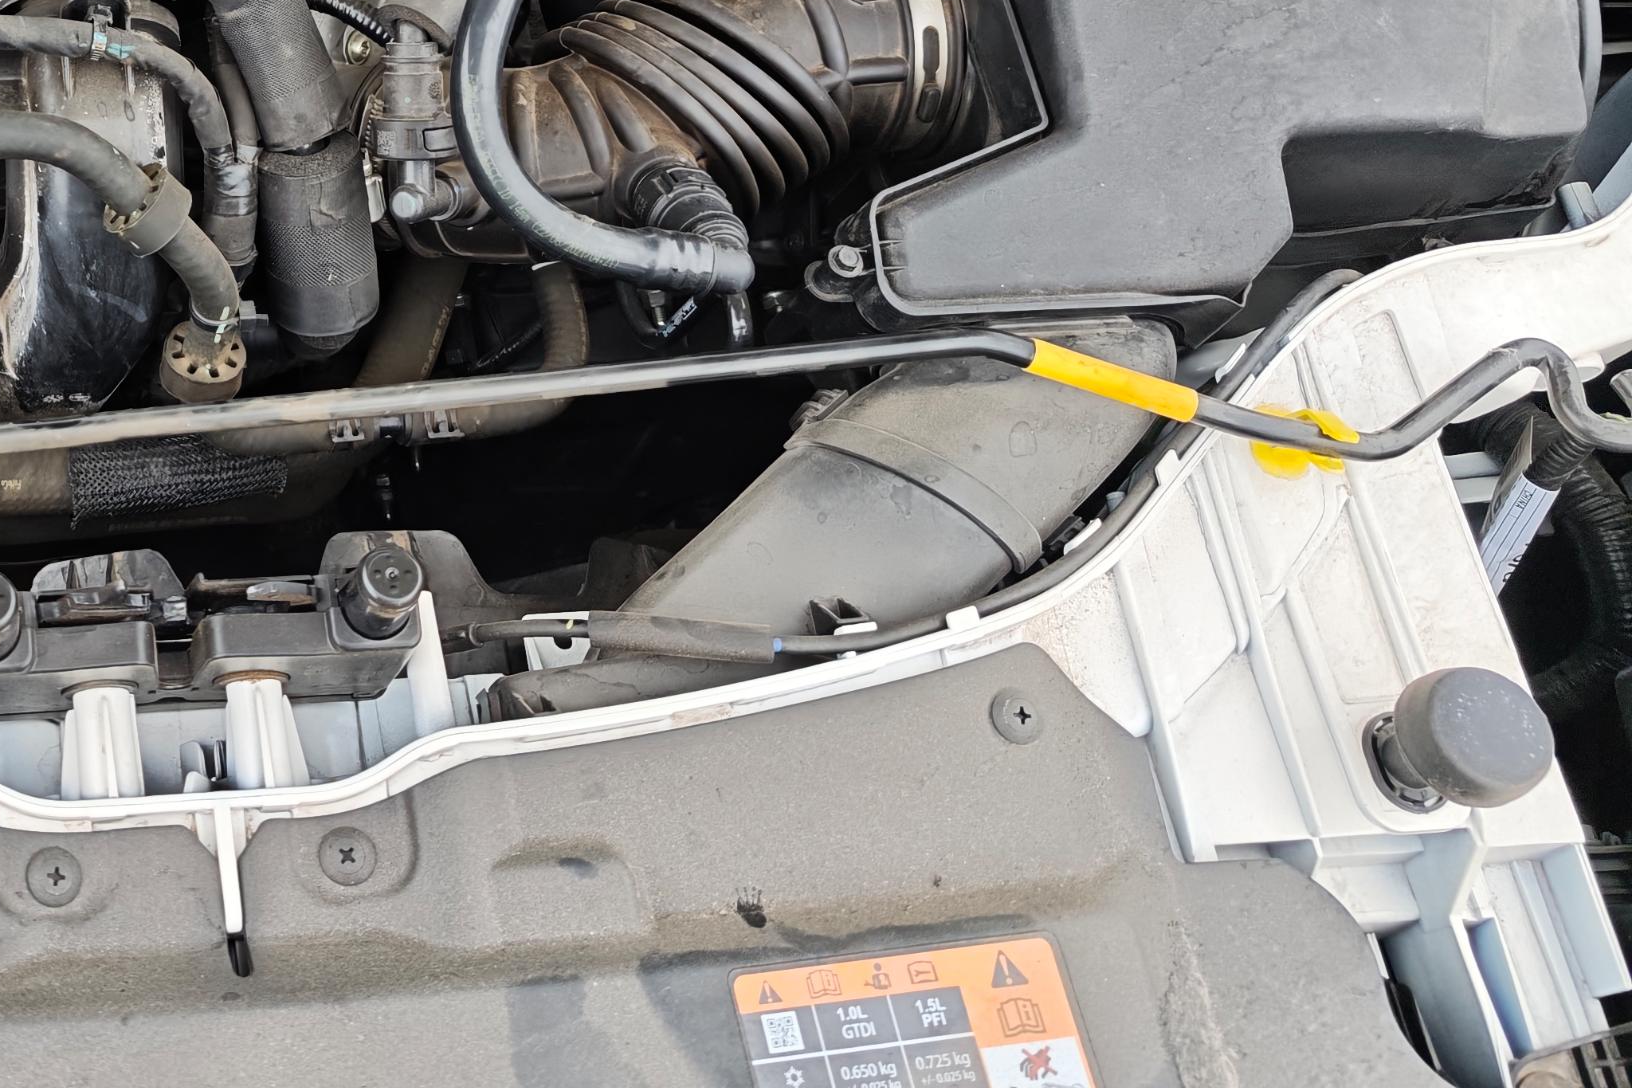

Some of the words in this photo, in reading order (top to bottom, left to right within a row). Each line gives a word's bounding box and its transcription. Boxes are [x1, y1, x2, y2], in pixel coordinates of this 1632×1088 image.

[1515, 489, 1534, 511] CHINA
[836, 1006, 869, 1022] 1.0L
[914, 998, 947, 1014] 1.5L
[921, 1013, 947, 1029] PFI
[841, 1022, 877, 1040] GTDI
[914, 1054, 952, 1072] 0.725
[953, 1051, 972, 1068] kg
[840, 1064, 878, 1081] 0.650
[878, 1060, 898, 1079] kg
[962, 1069, 977, 1083] kg
